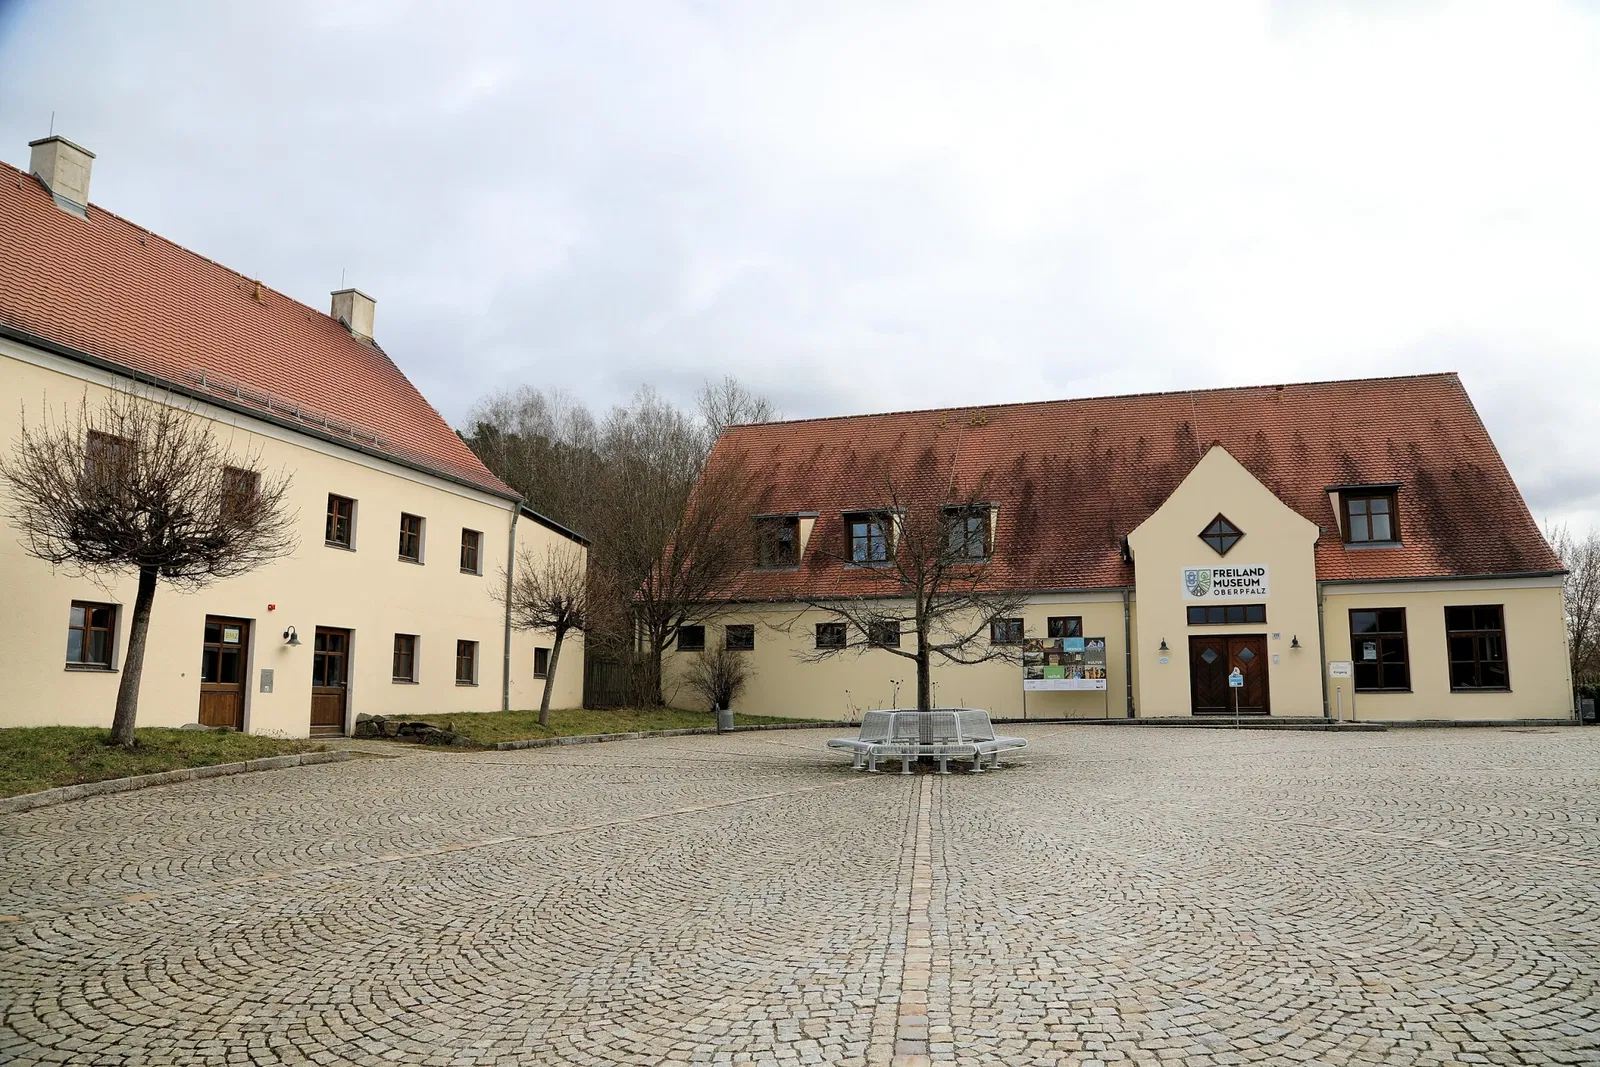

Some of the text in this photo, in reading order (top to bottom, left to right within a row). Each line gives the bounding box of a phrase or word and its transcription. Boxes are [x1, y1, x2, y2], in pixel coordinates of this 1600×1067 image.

[1213, 568, 1265, 578] FREILAND
[1214, 578, 1260, 588] MUSEUM
[1214, 588, 1266, 596] OBERPFALZ
